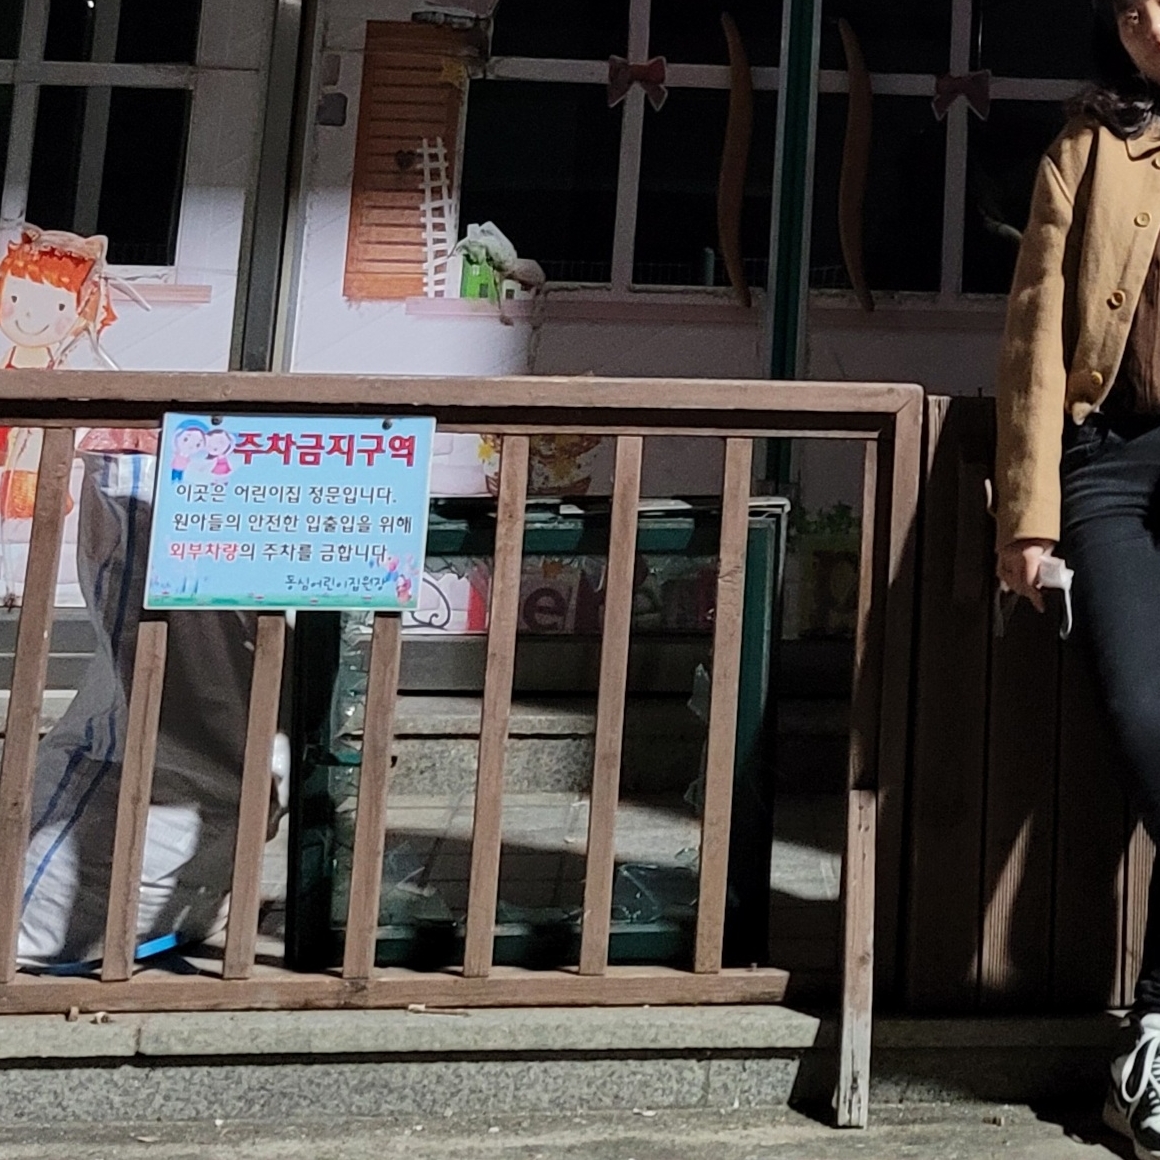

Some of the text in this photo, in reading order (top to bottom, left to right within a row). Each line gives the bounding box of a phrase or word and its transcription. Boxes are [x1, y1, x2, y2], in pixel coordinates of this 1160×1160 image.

[233, 432, 416, 467] 주차금지구역
[176, 484, 397, 505] 이곳은 어린이집 정문입니다.
[173, 513, 413, 534] 원아들의 안전한 입출입을 위해
[170, 542, 392, 563] 외부차량의 주차를 금합니다.
